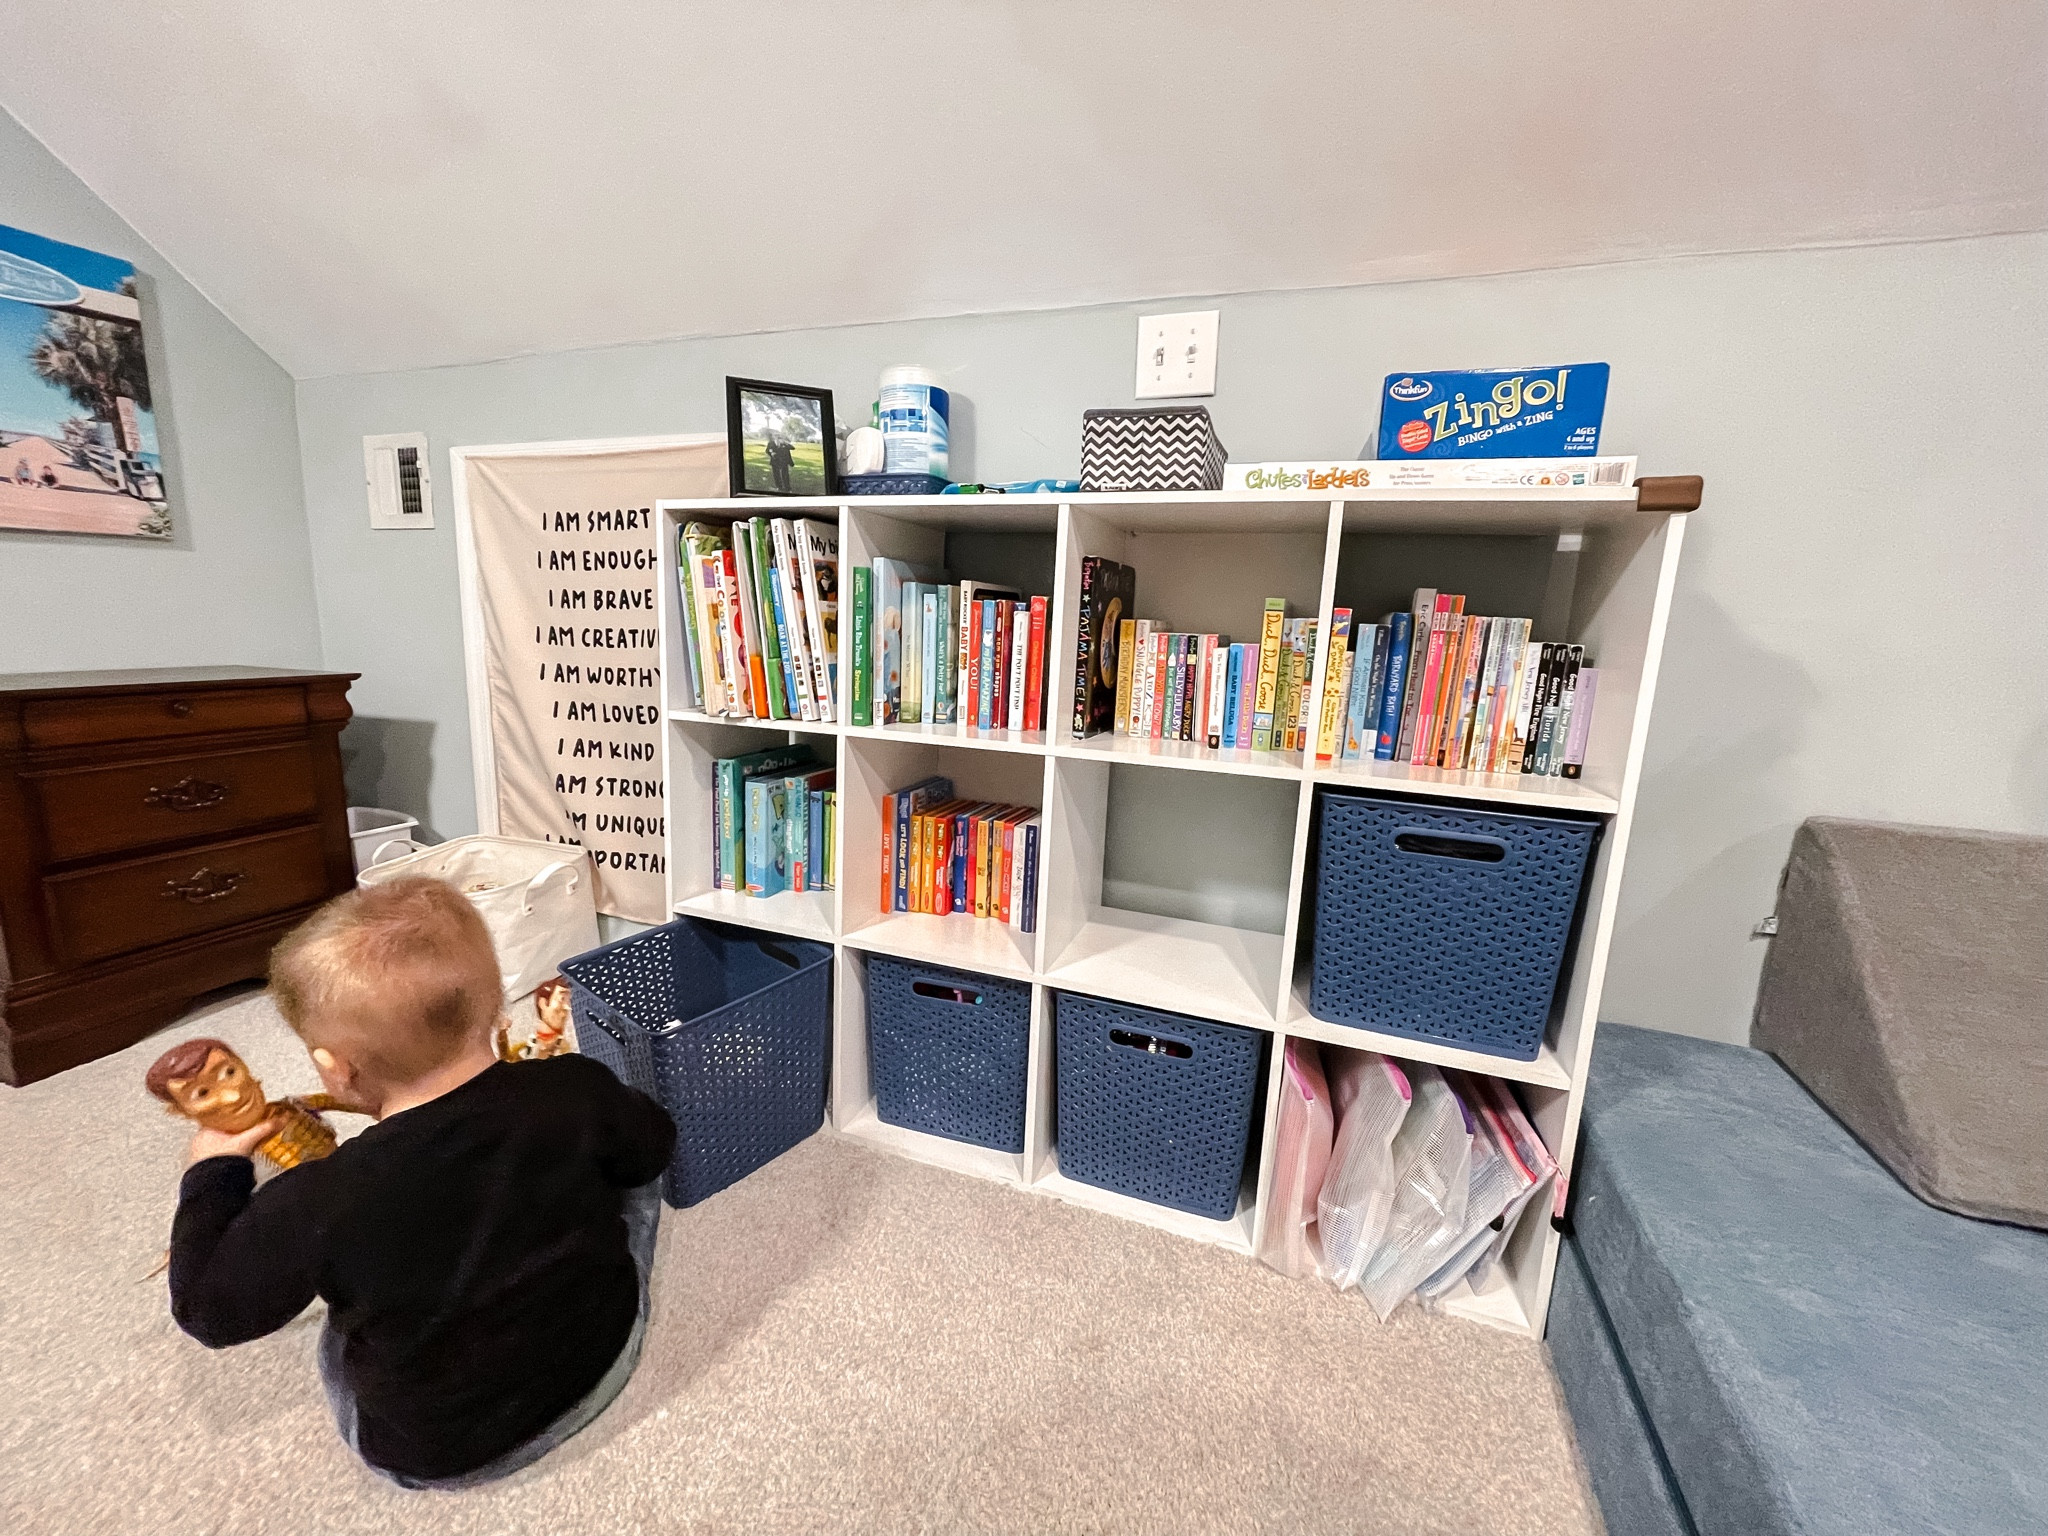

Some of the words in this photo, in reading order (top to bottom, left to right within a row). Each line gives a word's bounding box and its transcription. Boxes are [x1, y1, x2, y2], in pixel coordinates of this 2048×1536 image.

[1423, 369, 1570, 443] Zingo!
[1457, 428, 1494, 448] BINGO
[1496, 422, 1517, 435] with
[1524, 410, 1554, 427] ZING
[1575, 427, 1597, 435] AGES
[1572, 435, 1584, 443] and
[1585, 436, 1596, 445] up
[1245, 467, 1302, 490] Chutes
[1306, 466, 1371, 490] Ladders
[543, 512, 547, 531] I
[554, 511, 580, 532] AM
[587, 508, 650, 533] SMART
[810, 535, 827, 556] My
[537, 550, 542, 569] I
[549, 550, 576, 571] AM
[1082, 561, 1094, 590] Boynton
[549, 589, 553, 607] I
[560, 588, 586, 609] AM
[593, 588, 653, 611] BRAVE
[717, 590, 727, 630] Colors
[1420, 604, 1429, 619] Eric
[536, 625, 541, 644] I
[548, 625, 575, 647] AM
[581, 627, 660, 649] CREATIV
[777, 624, 787, 640] ROAR
[960, 626, 968, 650] BABY
[1078, 605, 1091, 660] PAJAMA
[1416, 622, 1426, 642] Carle
[781, 649, 789, 660] THE
[1120, 641, 1130, 674] BIRTHDAY
[1135, 646, 1145, 684] SNUGGLE
[1328, 652, 1337, 673] DANCE
[1412, 650, 1423, 671] From
[540, 663, 545, 681] I
[554, 663, 580, 683] AM
[970, 657, 978, 690] YOU!
[1076, 665, 1087, 700] TIME!
[1176, 667, 1185, 689] SILLY
[1388, 655, 1403, 692] BARNYARD
[1408, 672, 1419, 692] Head
[1539, 673, 1547, 687] Good
[1567, 673, 1577, 691] Good
[1147, 681, 1152, 690] TO
[1156, 679, 1164, 694] YOU
[1534, 688, 1545, 703] Night
[1551, 677, 1560, 694] Good
[1132, 687, 1143, 715] PUPPY!
[1257, 682, 1273, 711] Goose
[1386, 696, 1396, 716] BATH!
[1408, 693, 1414, 701] to
[1545, 695, 1558, 713] Night
[1563, 692, 1574, 710] Night
[553, 701, 559, 718] I
[567, 701, 596, 722] AM
[602, 703, 659, 725] LOVED
[1153, 703, 1162, 726] COW?
[1172, 694, 1183, 730] LULLABY
[1228, 696, 1236, 725] BELUGA
[1533, 704, 1544, 716] Fire
[1561, 711, 1571, 724] New
[1288, 715, 1297, 729] 123
[1529, 717, 1540, 742] Engines
[1542, 715, 1556, 743] Florida
[1556, 726, 1569, 744] Jersey
[558, 738, 564, 755] I
[573, 738, 602, 759] AM
[609, 741, 655, 762] KIND
[555, 773, 587, 794] AM
[804, 781, 808, 794] MY
[899, 838, 907, 858] LOOK
